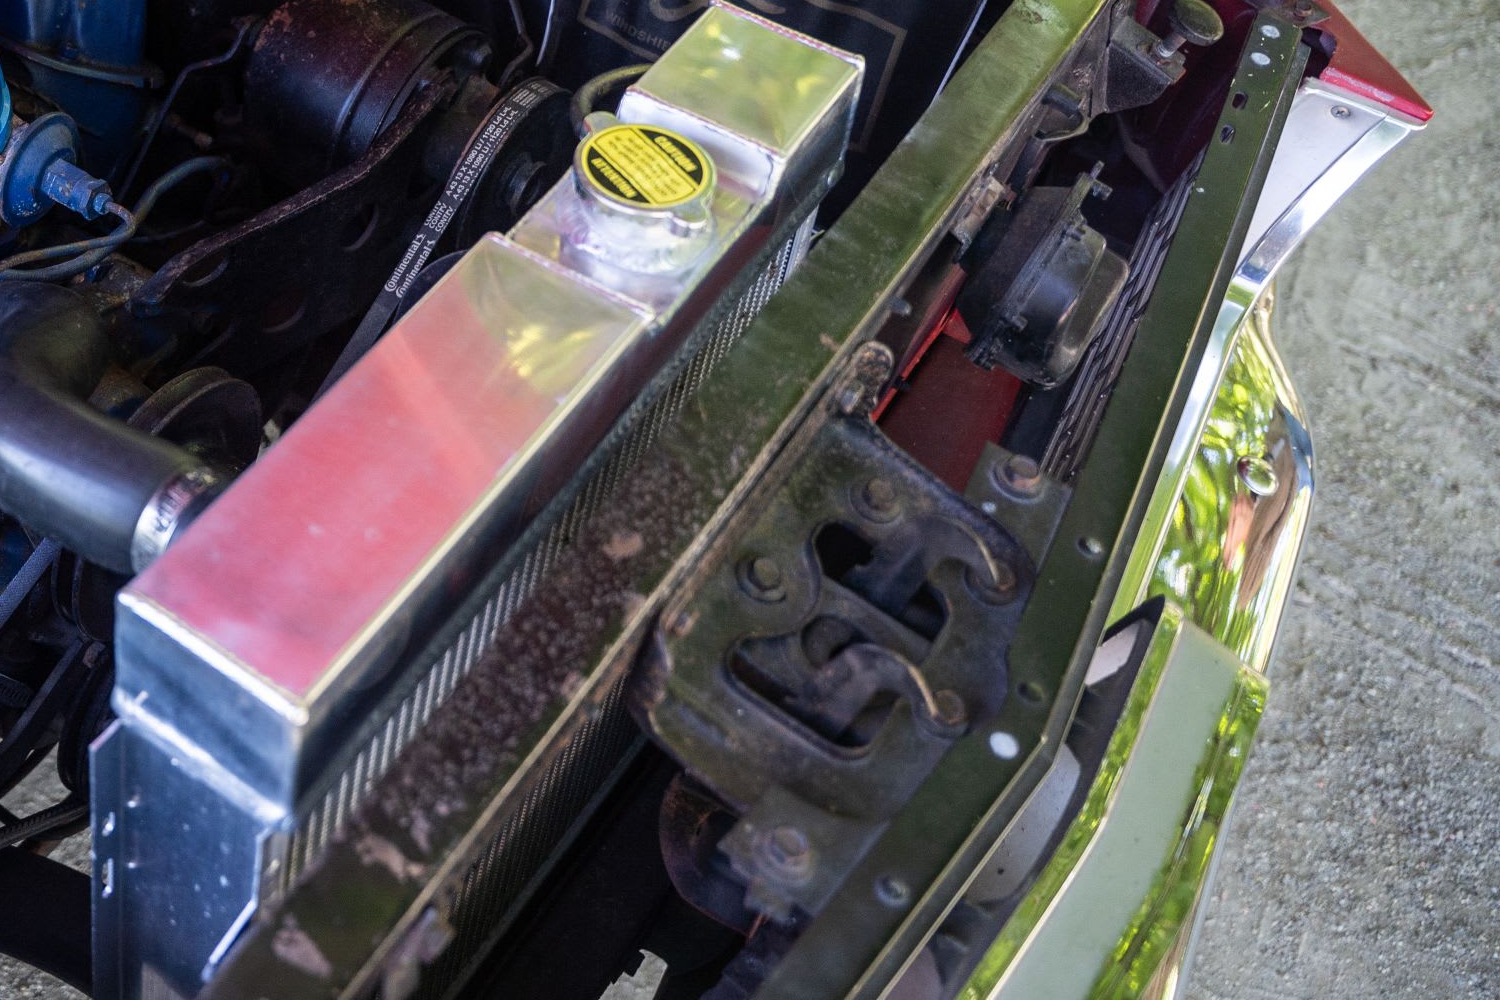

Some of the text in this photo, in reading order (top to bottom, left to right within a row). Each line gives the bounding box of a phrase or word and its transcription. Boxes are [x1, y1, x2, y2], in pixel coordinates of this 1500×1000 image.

[448, 180, 458, 190] 43
[454, 170, 463, 180] 13
[482, 123, 496, 139] 1120
[455, 183, 465, 194] 43
[461, 174, 470, 184] 13
[471, 152, 484, 169] 1090
[488, 126, 502, 143] 1120
[654, 136, 697, 172] CAUTION
[383, 239, 420, 292] Continental
